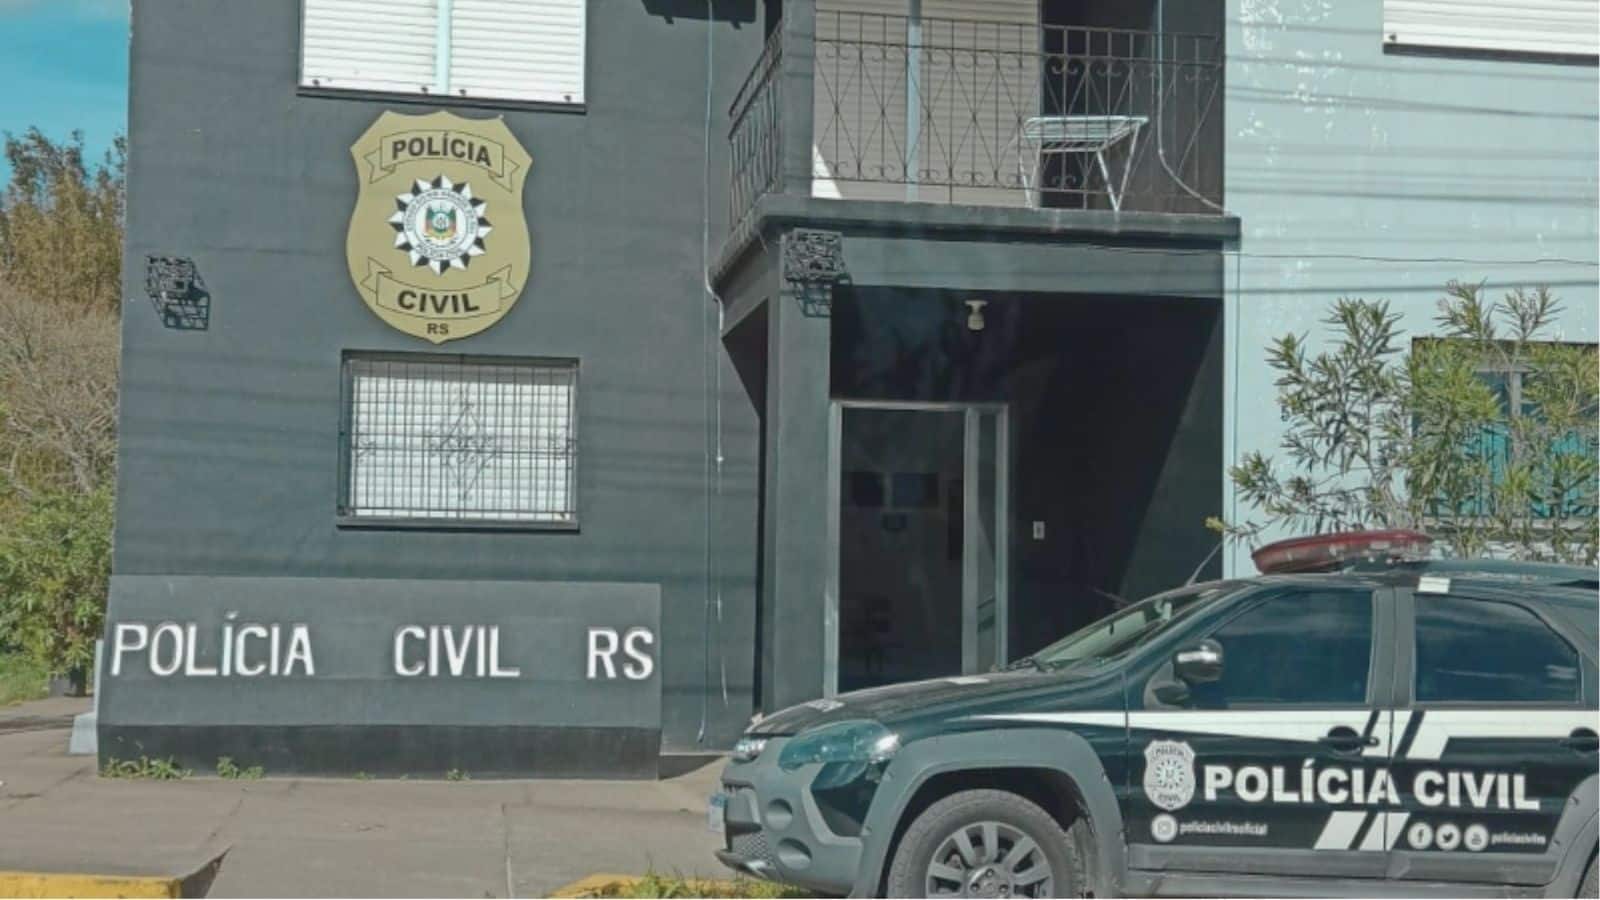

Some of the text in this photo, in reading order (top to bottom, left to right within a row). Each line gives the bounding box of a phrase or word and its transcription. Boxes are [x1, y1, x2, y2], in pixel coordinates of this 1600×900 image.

[392, 133, 492, 167] POLÍCIA
[396, 290, 481, 314] CIVIL
[427, 323, 450, 335] RS
[111, 611, 654, 680] POLÍCIA CIVIL RS
[1204, 760, 1541, 810] POLÍCIA CIVIL
